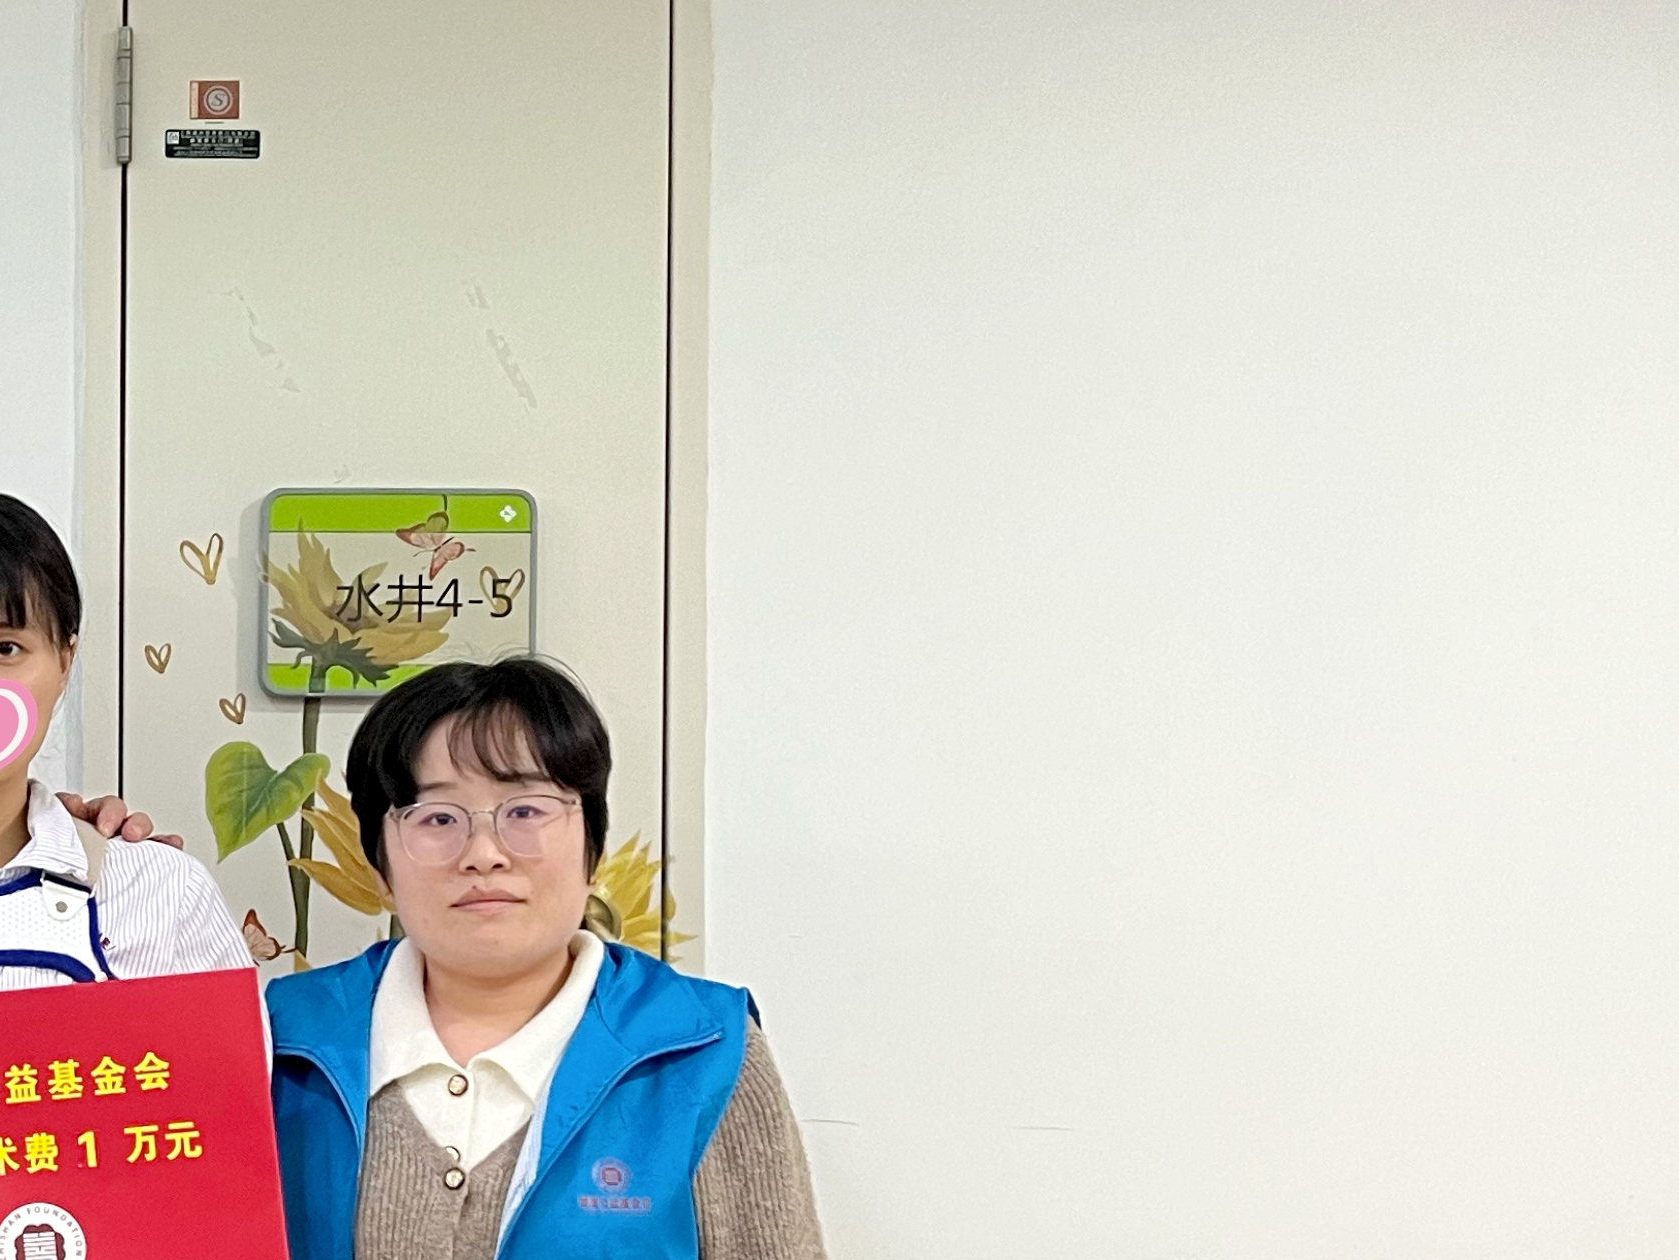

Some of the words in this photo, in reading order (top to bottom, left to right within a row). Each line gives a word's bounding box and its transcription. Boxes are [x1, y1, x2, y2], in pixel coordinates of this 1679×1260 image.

[336, 574, 513, 623] 水井4-5
[77, 1130, 99, 1168] 1
[123, 1121, 203, 1164] 万元
[26, 1206, 83, 1257] FOUNDATION
